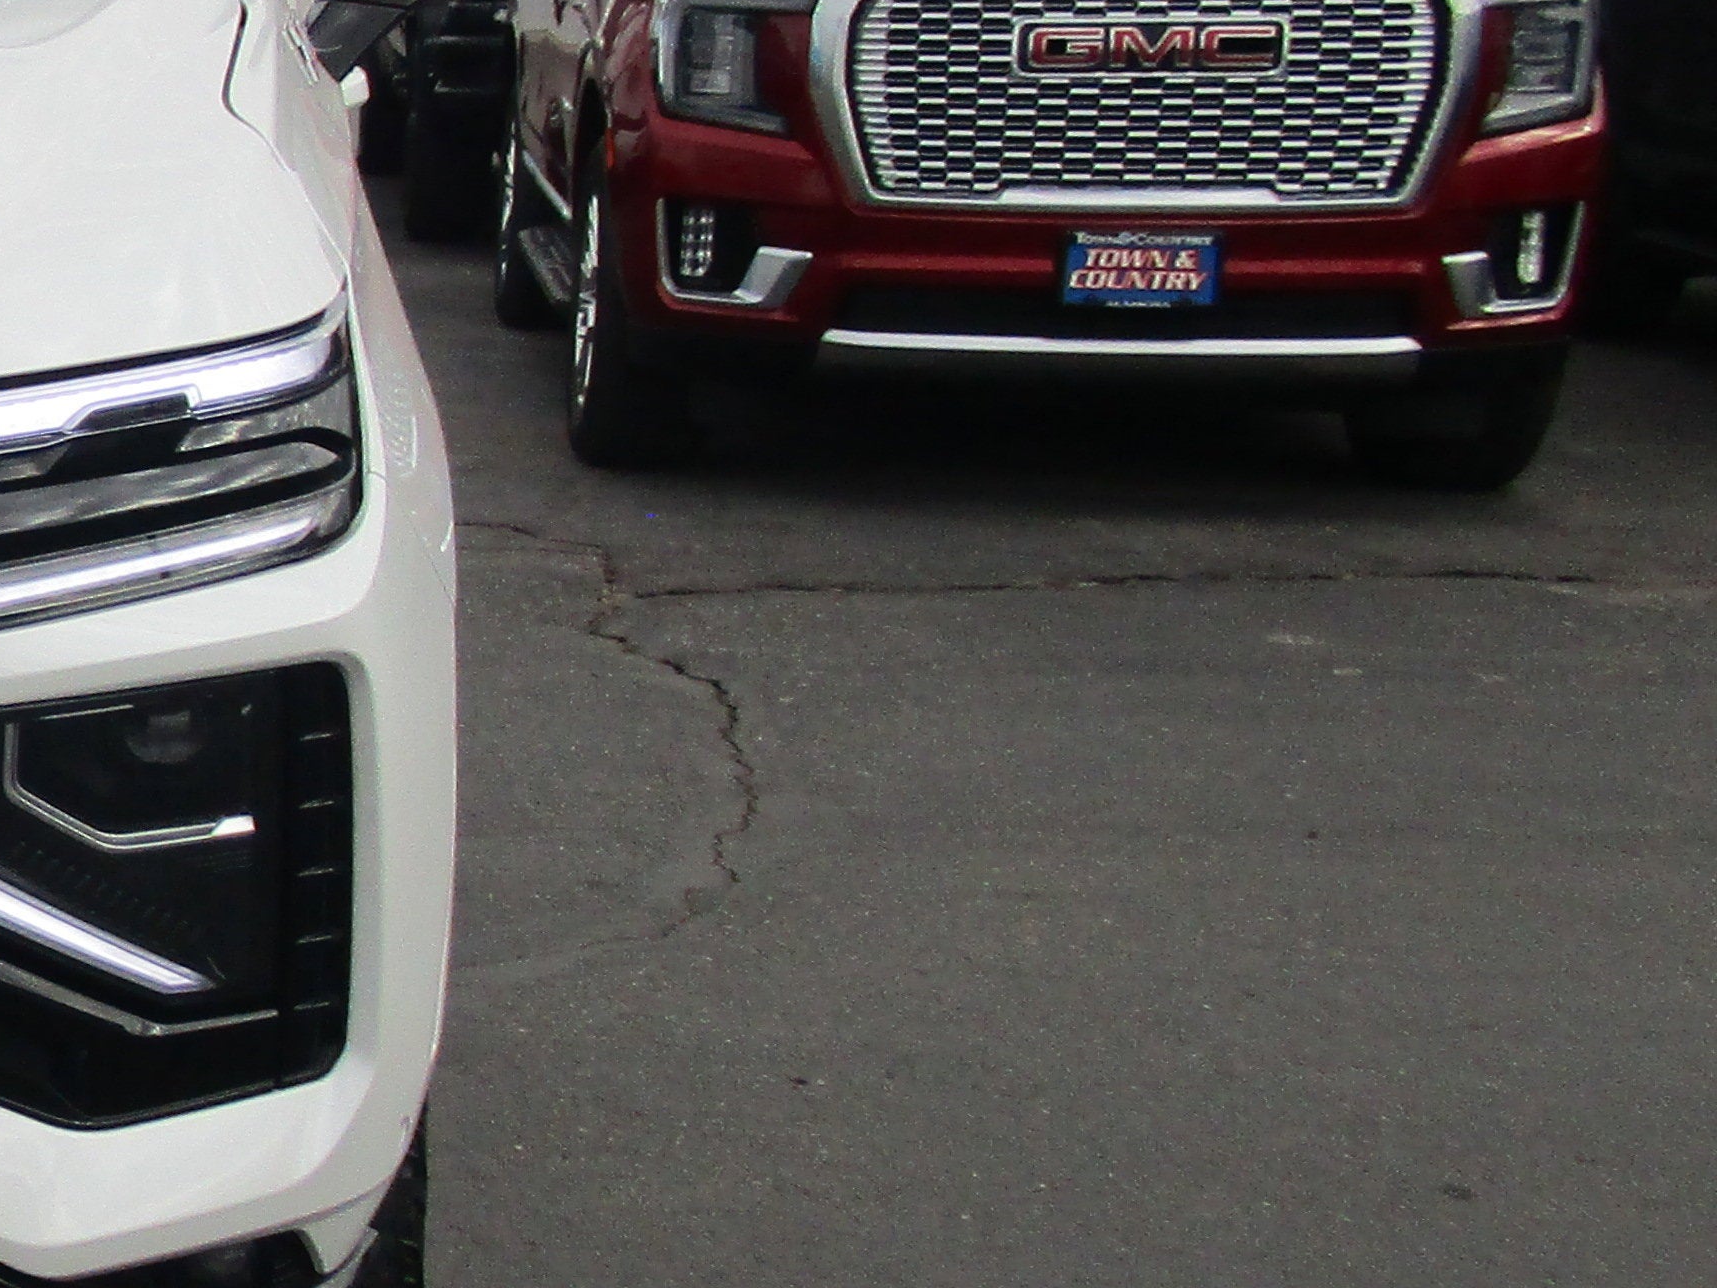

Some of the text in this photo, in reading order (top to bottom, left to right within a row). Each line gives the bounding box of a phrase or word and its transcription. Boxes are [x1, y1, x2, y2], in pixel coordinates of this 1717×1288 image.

[1029, 26, 1278, 67] GMC
[1084, 248, 1199, 269] TOWN &
[1068, 269, 1206, 290] COUNTRY
